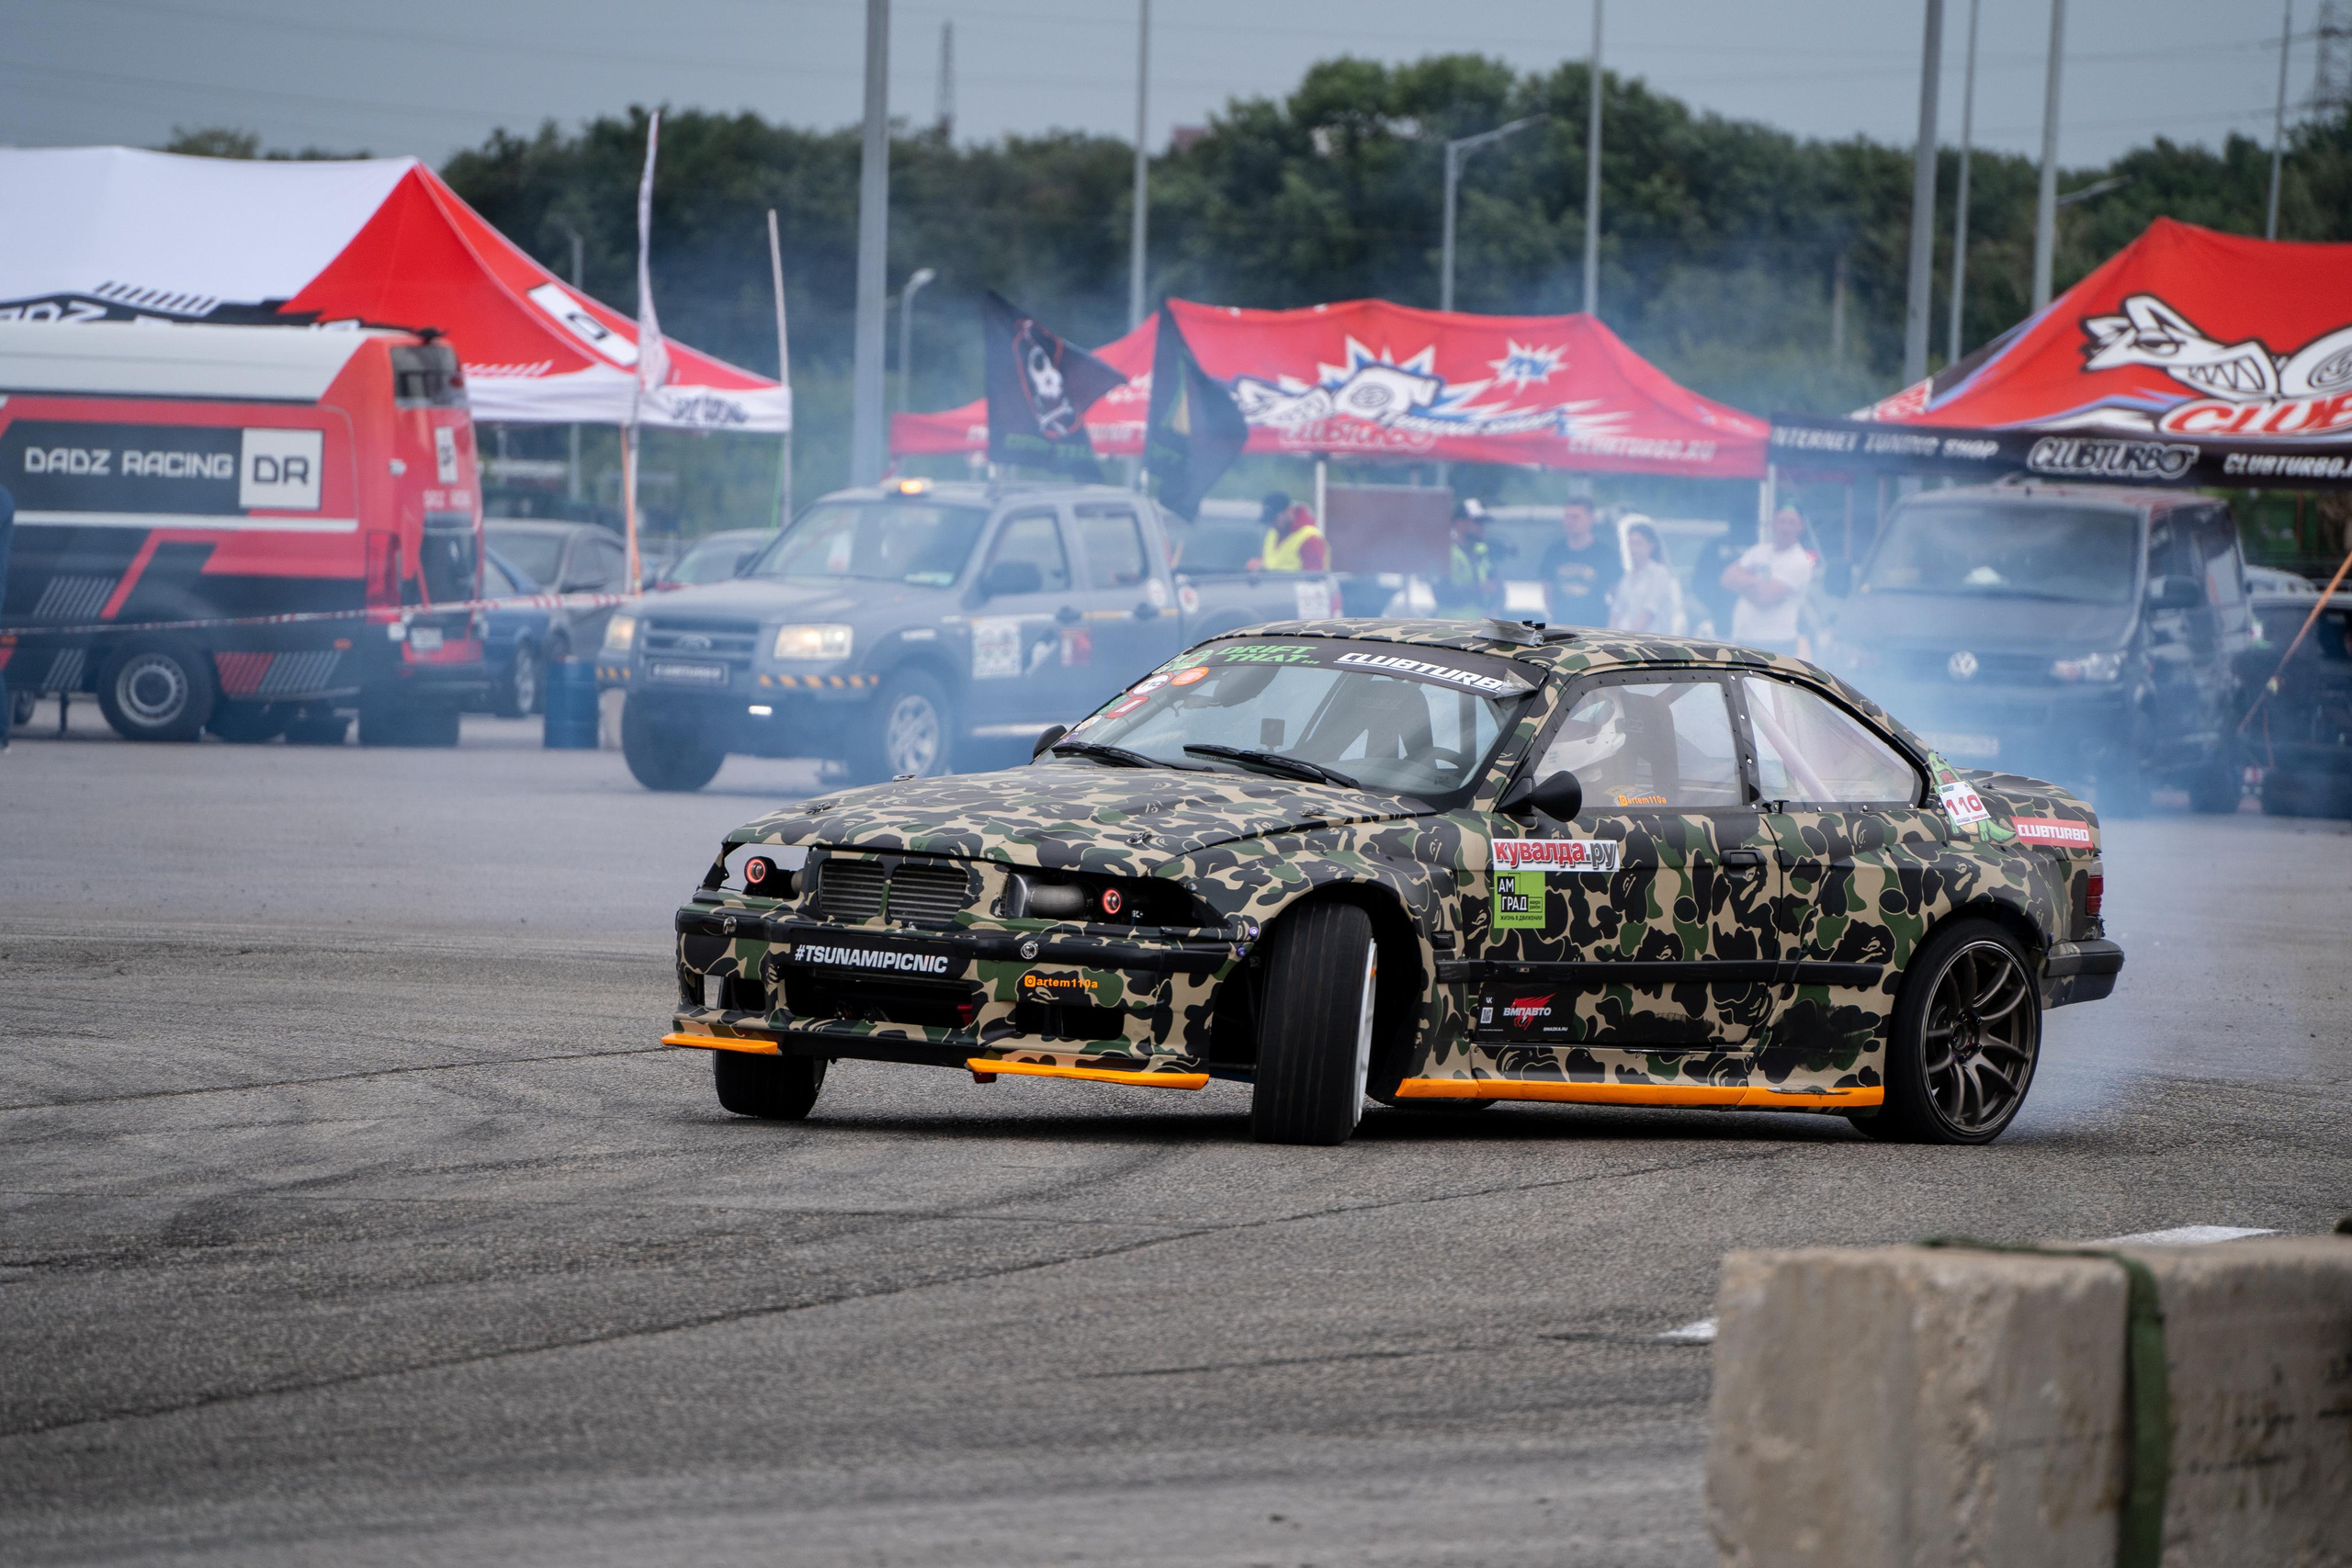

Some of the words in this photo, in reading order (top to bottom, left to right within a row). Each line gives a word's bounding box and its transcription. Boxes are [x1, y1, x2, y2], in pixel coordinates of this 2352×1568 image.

[1942, 438, 2000, 459] SHOP
[2027, 436, 2200, 479] CLUBTURBO
[25, 446, 111, 476] DADZ
[121, 449, 233, 479] RACING
[252, 454, 310, 485] DR
[1215, 645, 1318, 656] DRIFT
[1223, 653, 1321, 665] THAT...
[1335, 652, 1506, 692] CLUBTURB
[1945, 794, 1984, 816] 110
[2017, 823, 2090, 842] CLUBTURBO
[1493, 841, 1617, 870] кувалда.ру
[1498, 878, 1515, 893] АМ
[1501, 897, 1528, 911] ГРАД
[795, 944, 948, 974] #TSUNAMIPICNIC
[1036, 978, 1098, 988] artem110a
[1503, 1007, 1552, 1016] ВМПАВТО
